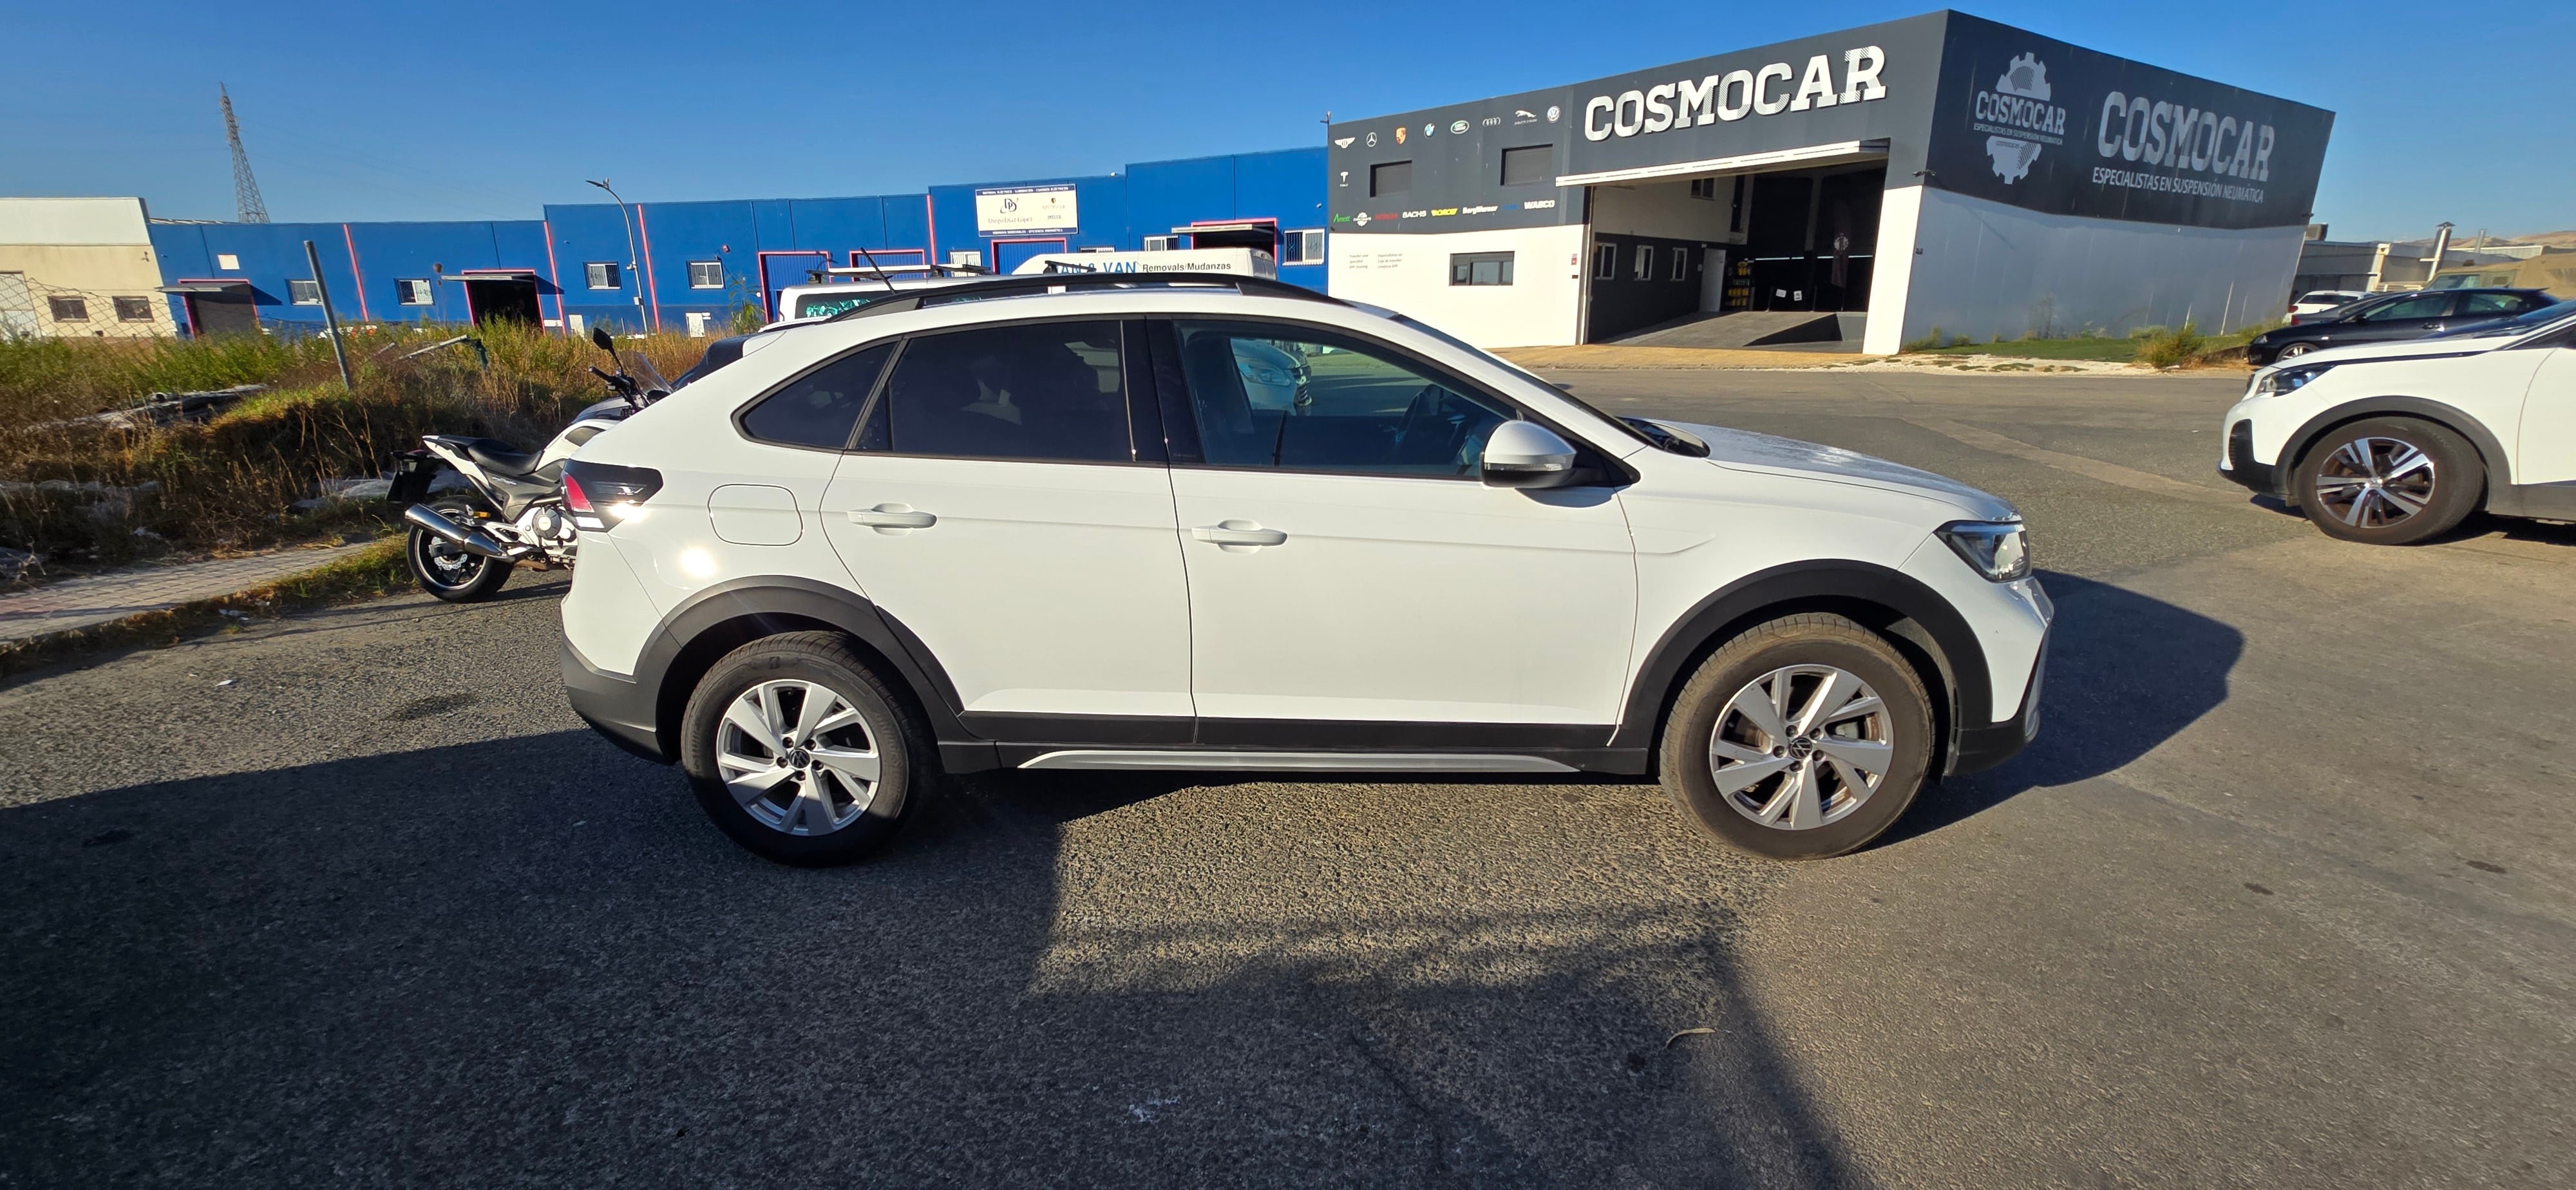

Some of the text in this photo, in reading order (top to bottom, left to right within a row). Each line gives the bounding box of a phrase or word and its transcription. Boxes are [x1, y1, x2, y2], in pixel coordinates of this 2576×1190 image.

[1584, 45, 1887, 141] COSMOCAR
[1975, 90, 2066, 135] COSMOCAR
[1973, 122, 2006, 136] ESPECIALISTAS
[2013, 129, 2040, 141] SUSPENSIÓN
[2098, 91, 2275, 182] COSMOCAR
[2092, 166, 2264, 204] ESPECIALISTAS EN SUSPENSIÓN NEUMÁTICA
[1402, 210, 1427, 218] SACHS
[1524, 200, 1555, 209] WABCO
[1103, 261, 1137, 274] VAN
[1142, 263, 1231, 272] Removals/Mudanzas
